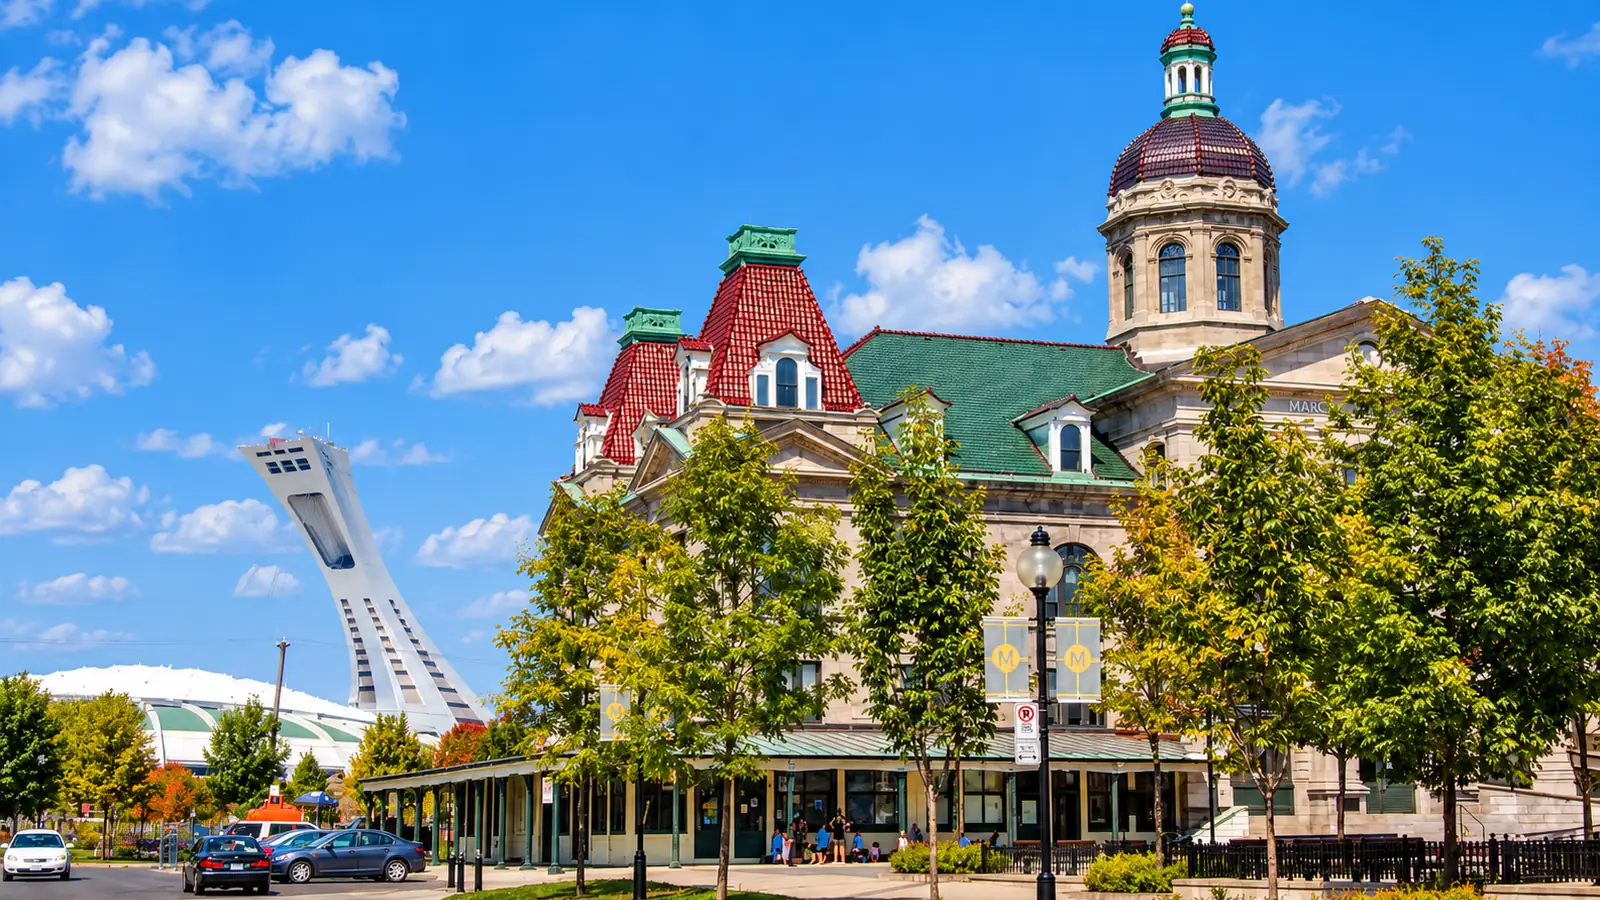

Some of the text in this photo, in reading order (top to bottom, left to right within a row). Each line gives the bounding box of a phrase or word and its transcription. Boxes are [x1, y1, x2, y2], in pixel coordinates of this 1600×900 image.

[1289, 400, 1328, 413] MARC
[998, 649, 1014, 667] M
[1070, 650, 1086, 667] M
